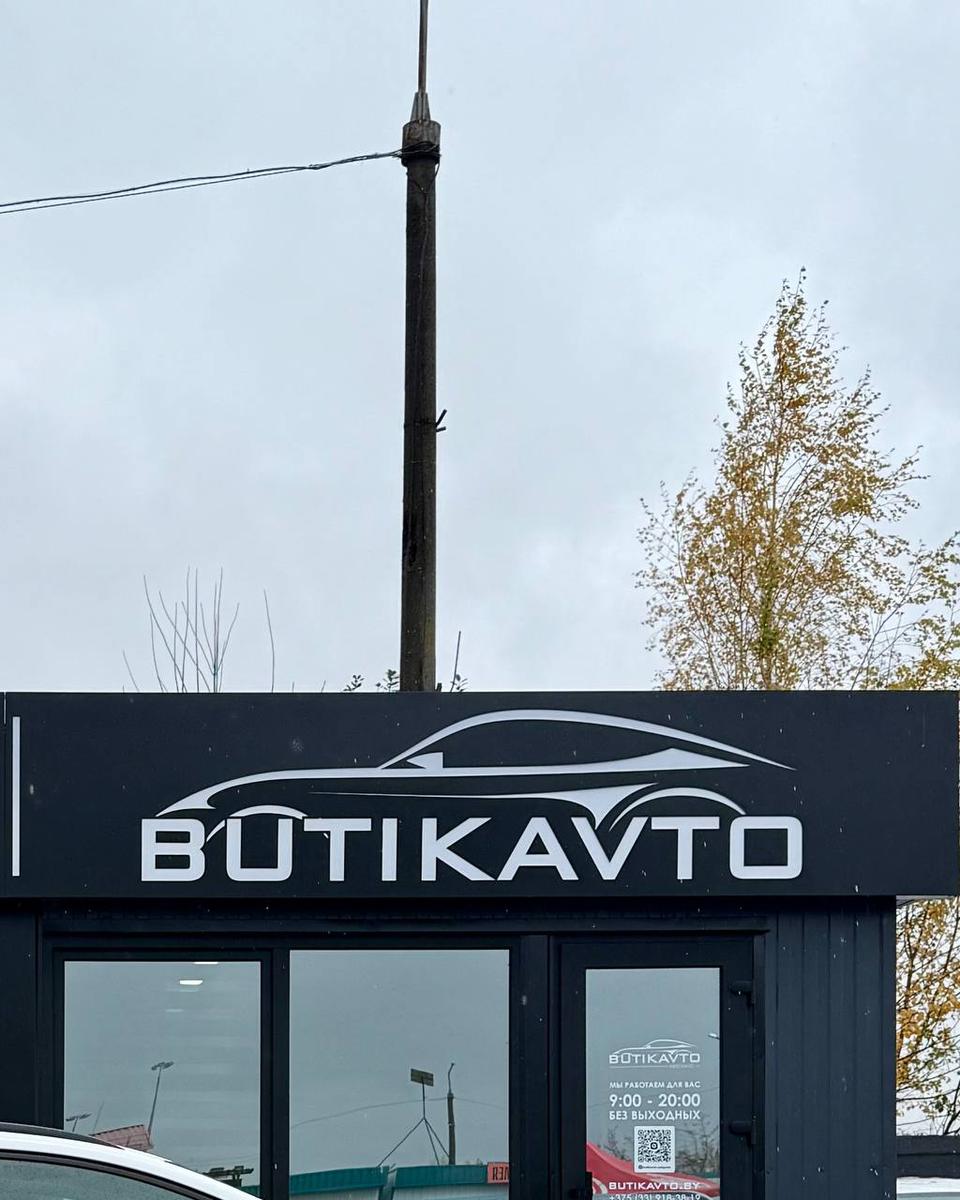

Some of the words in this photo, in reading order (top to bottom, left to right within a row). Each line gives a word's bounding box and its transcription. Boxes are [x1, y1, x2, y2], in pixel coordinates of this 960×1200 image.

[141, 816, 803, 882] BUTIKAVTO
[609, 1053, 701, 1064] BUTIKAVTO
[609, 1081, 623, 1089] МЫ
[624, 1081, 665, 1089] РАБОТАЕМ
[666, 1081, 683, 1090] ДЛЯ
[684, 1081, 701, 1089] ВАС
[609, 1093, 642, 1108] 9:00
[658, 1093, 701, 1108] 20:00
[609, 1110, 628, 1121] БЕЗ
[631, 1110, 701, 1122] ВЫХОДНЫХ
[609, 1182, 700, 1191] BUTIKAVTO.BY
